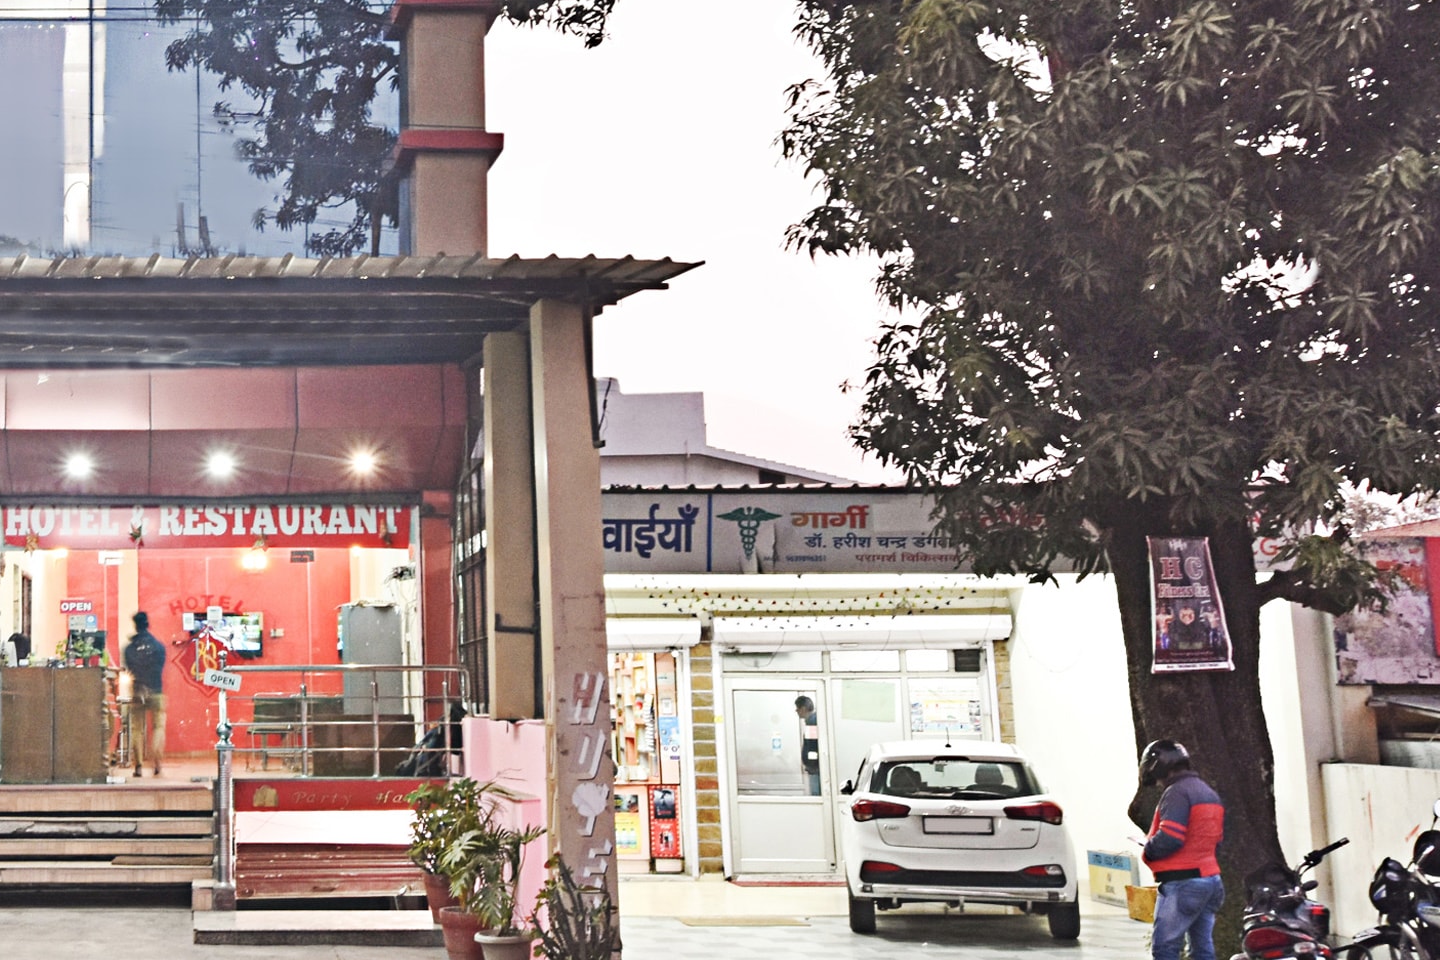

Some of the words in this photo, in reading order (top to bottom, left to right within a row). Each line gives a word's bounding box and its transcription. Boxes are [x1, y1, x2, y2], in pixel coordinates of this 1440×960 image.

[5, 505, 119, 536] HOTEL
[160, 504, 401, 536] RESTAURANT
[790, 505, 869, 528] गार्गी
[804, 533, 826, 548] डॉ.
[833, 533, 871, 548] हरीश
[61, 601, 92, 612] OPEN
[169, 594, 245, 616] HOTEL
[210, 673, 236, 687] OPEN
[292, 791, 352, 807] Party
